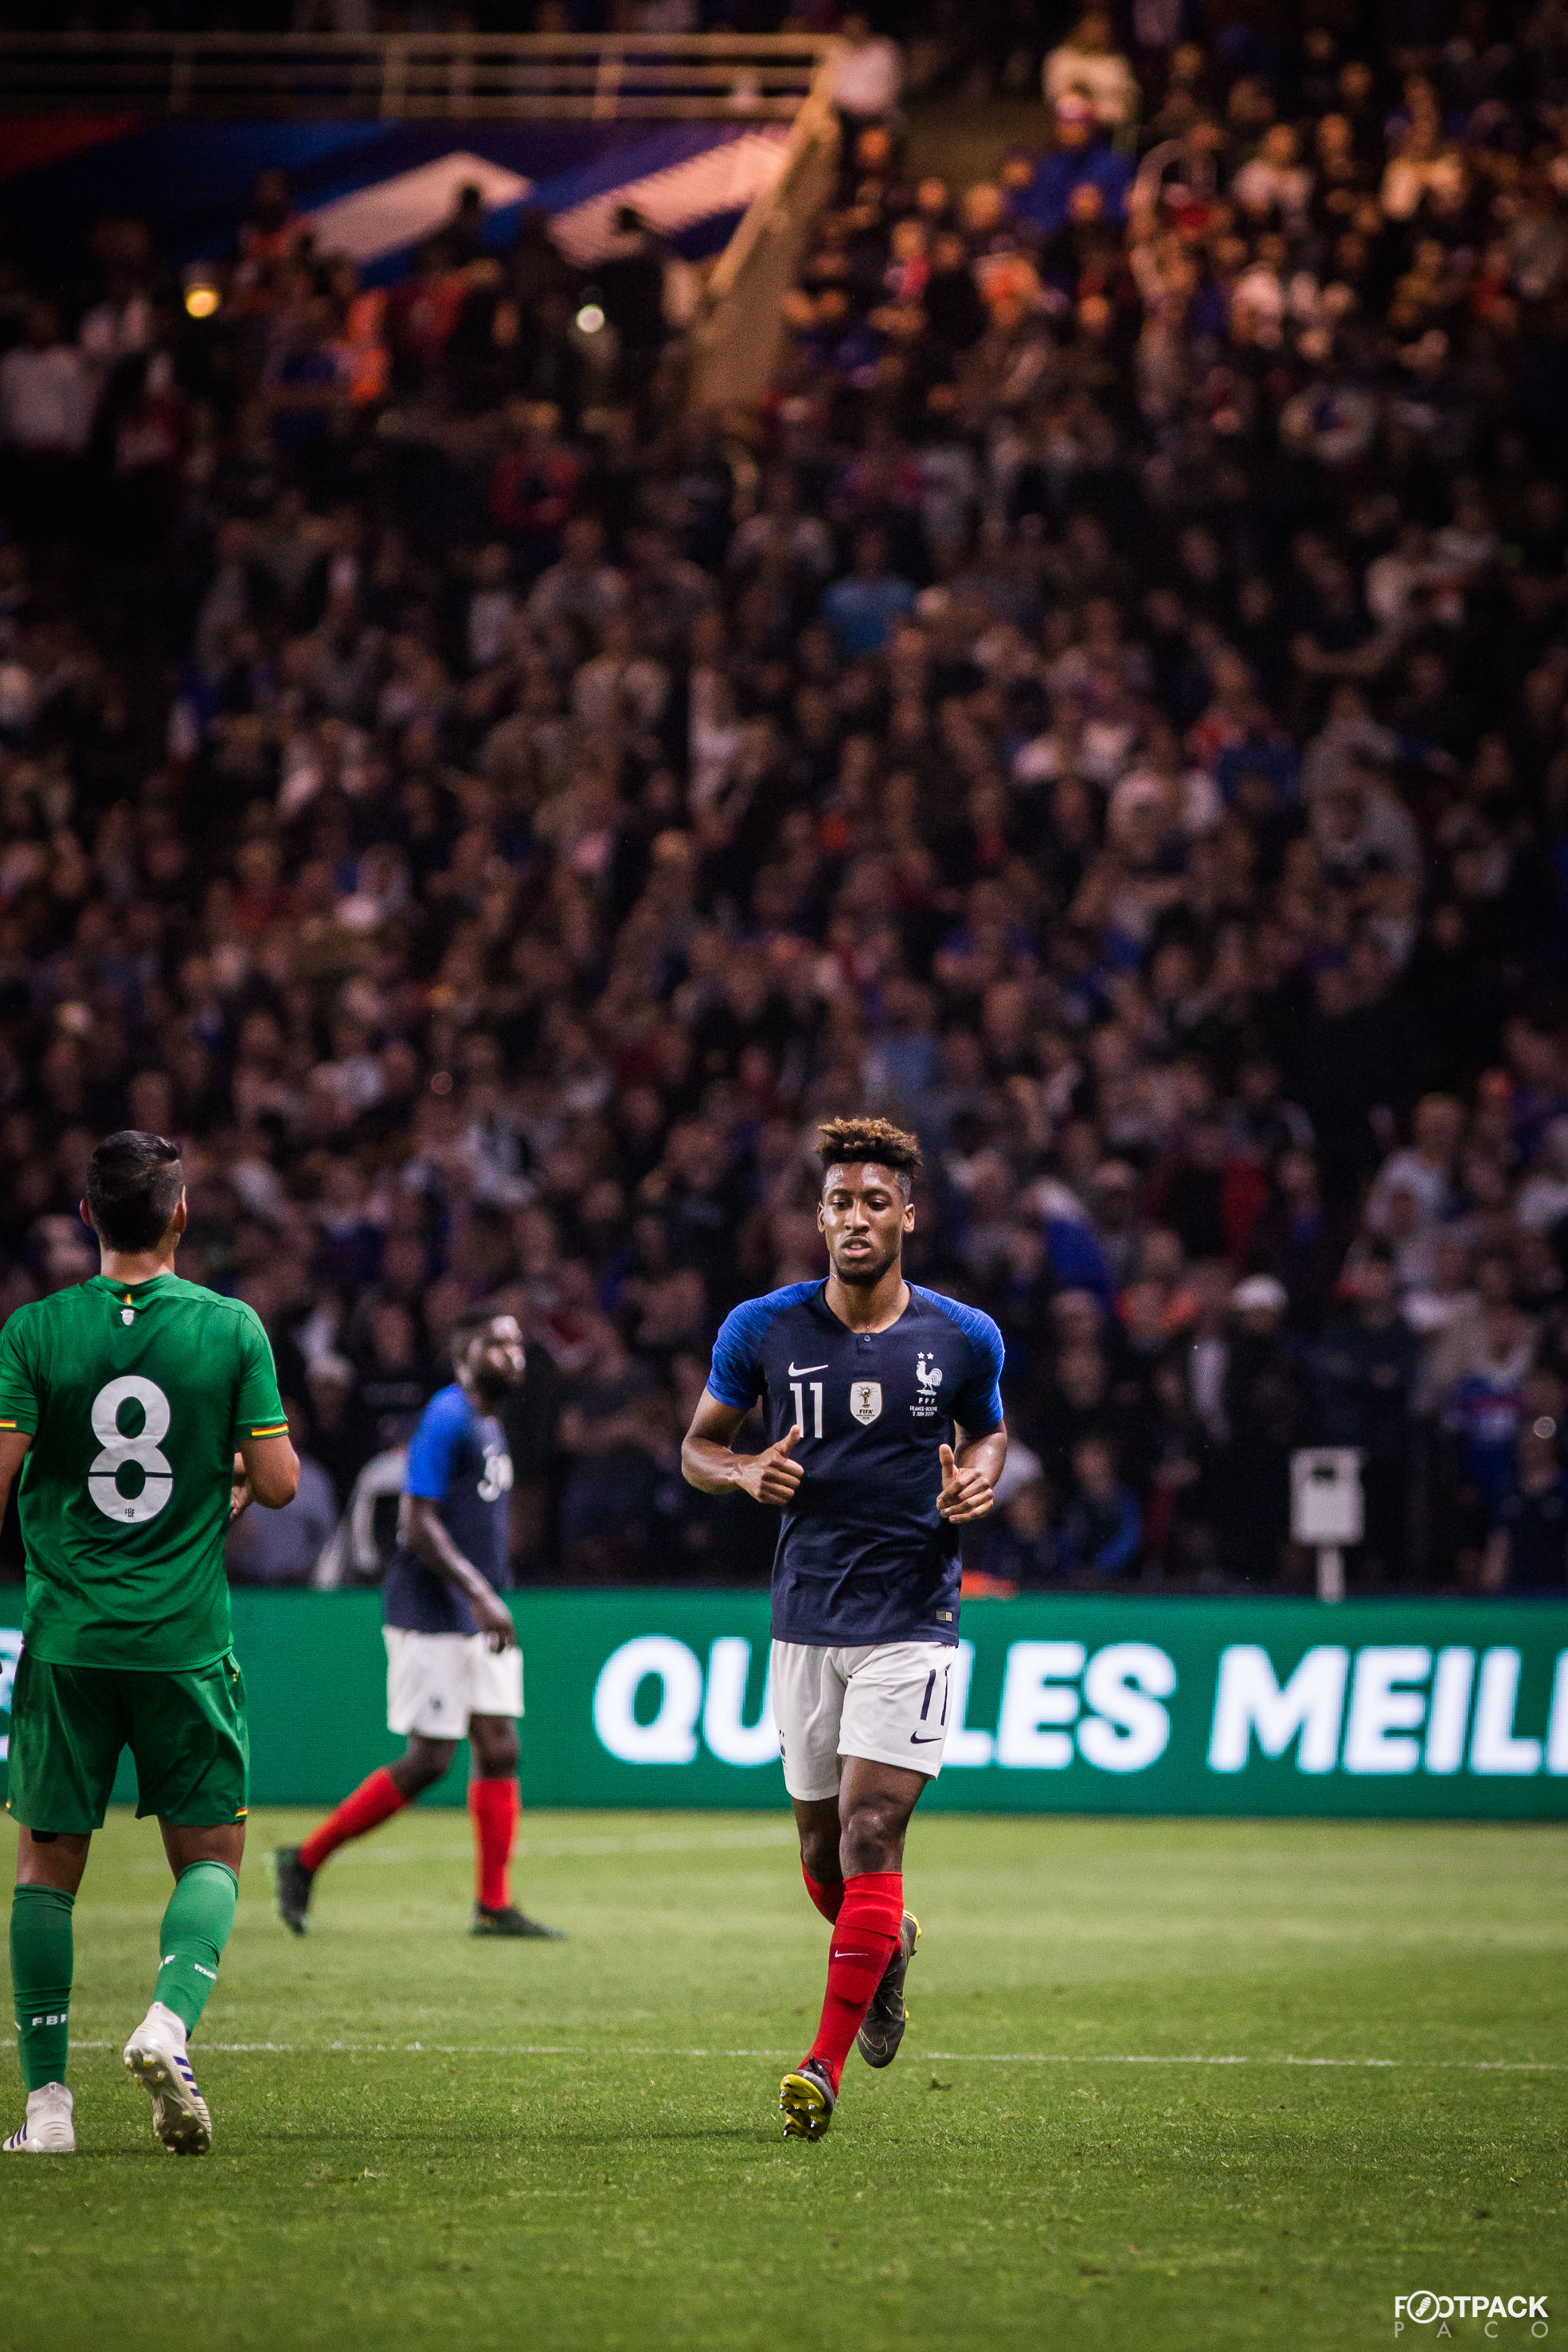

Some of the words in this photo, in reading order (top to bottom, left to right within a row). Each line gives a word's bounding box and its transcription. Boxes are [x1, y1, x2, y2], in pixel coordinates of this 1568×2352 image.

[88, 1375, 173, 1524] 8
[789, 1382, 823, 1439] 11
[592, 1634, 780, 1767] QU
[942, 1640, 1178, 1774] LES
